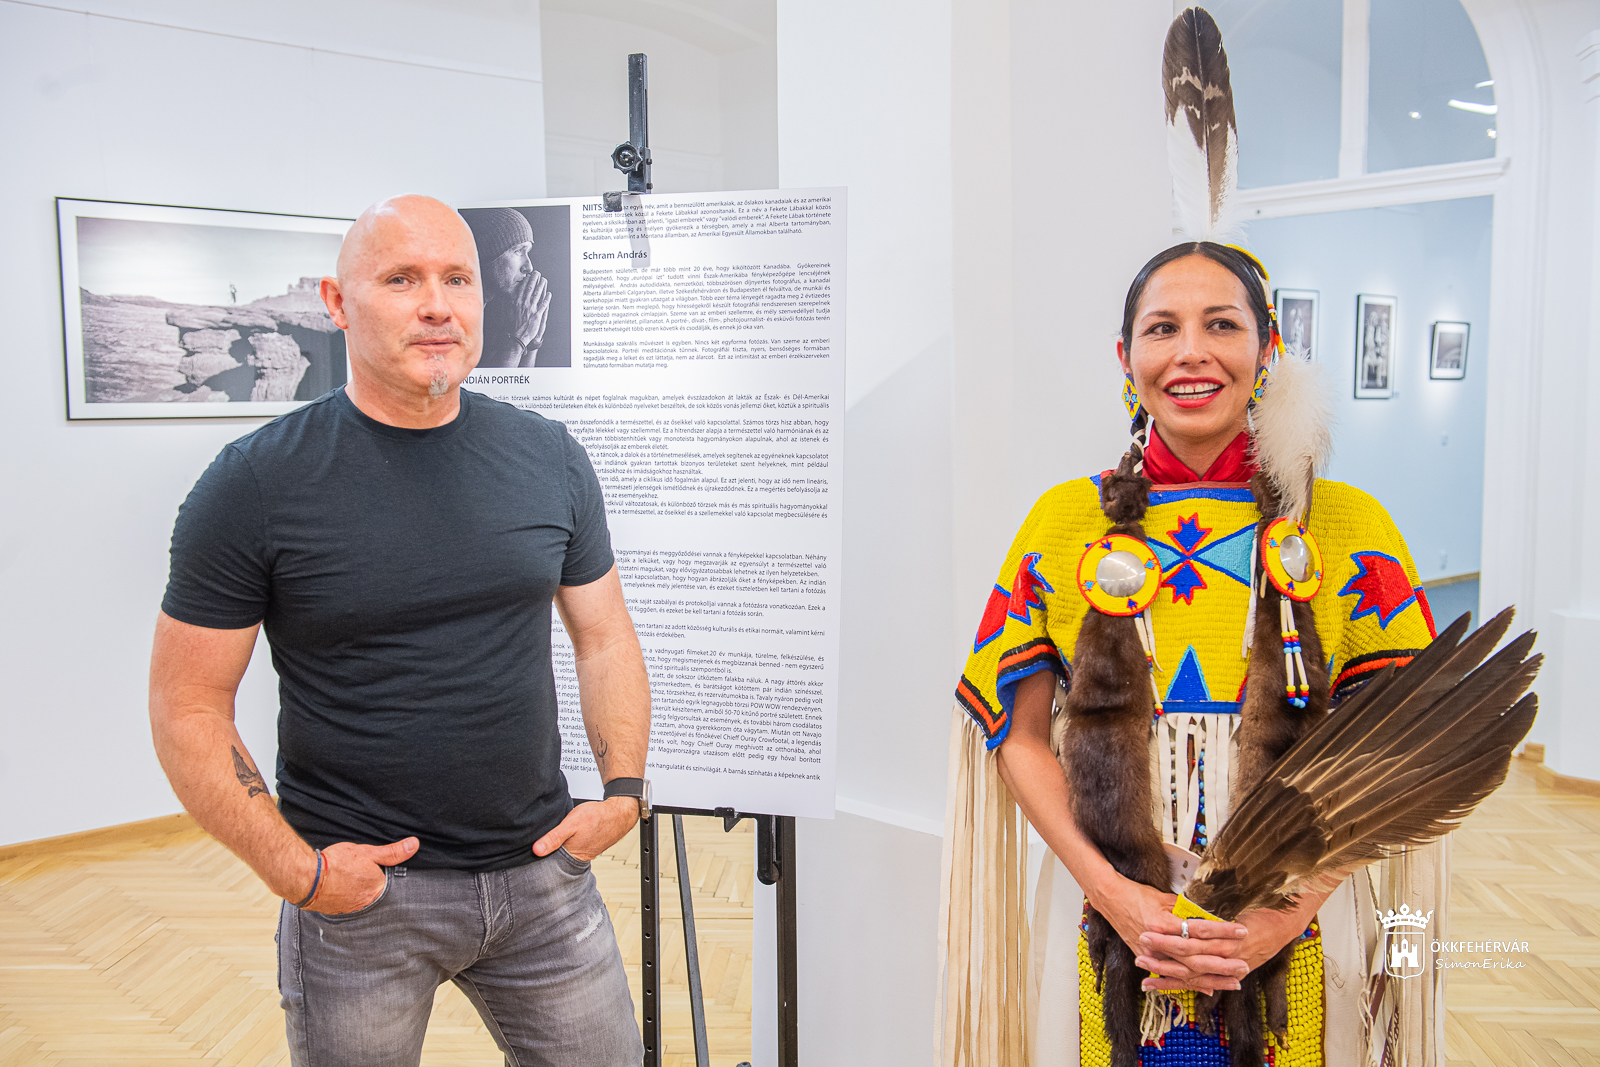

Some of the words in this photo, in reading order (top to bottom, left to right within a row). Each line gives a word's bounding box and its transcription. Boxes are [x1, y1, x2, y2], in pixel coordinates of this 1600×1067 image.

[590, 226, 612, 234] kultúrája
[615, 226, 634, 234] gazdag
[643, 225, 663, 233] mélyen
[666, 224, 693, 232] gyökerezik
[732, 222, 748, 230] amely
[721, 230, 744, 238] Egyesült
[583, 251, 614, 259] Schram
[617, 250, 647, 259] András
[462, 375, 490, 384] NDIÁN
[492, 374, 530, 384] PORTRÉK
[804, 553, 827, 562] Néhány
[672, 575, 686, 583] hogy
[687, 575, 708, 584] hogyan
[709, 576, 737, 584] ábrázolják
[802, 730, 822, 739] Navajo
[728, 767, 746, 775] barnás
[748, 768, 772, 777] színhatás
[778, 771, 805, 781] képeknek
